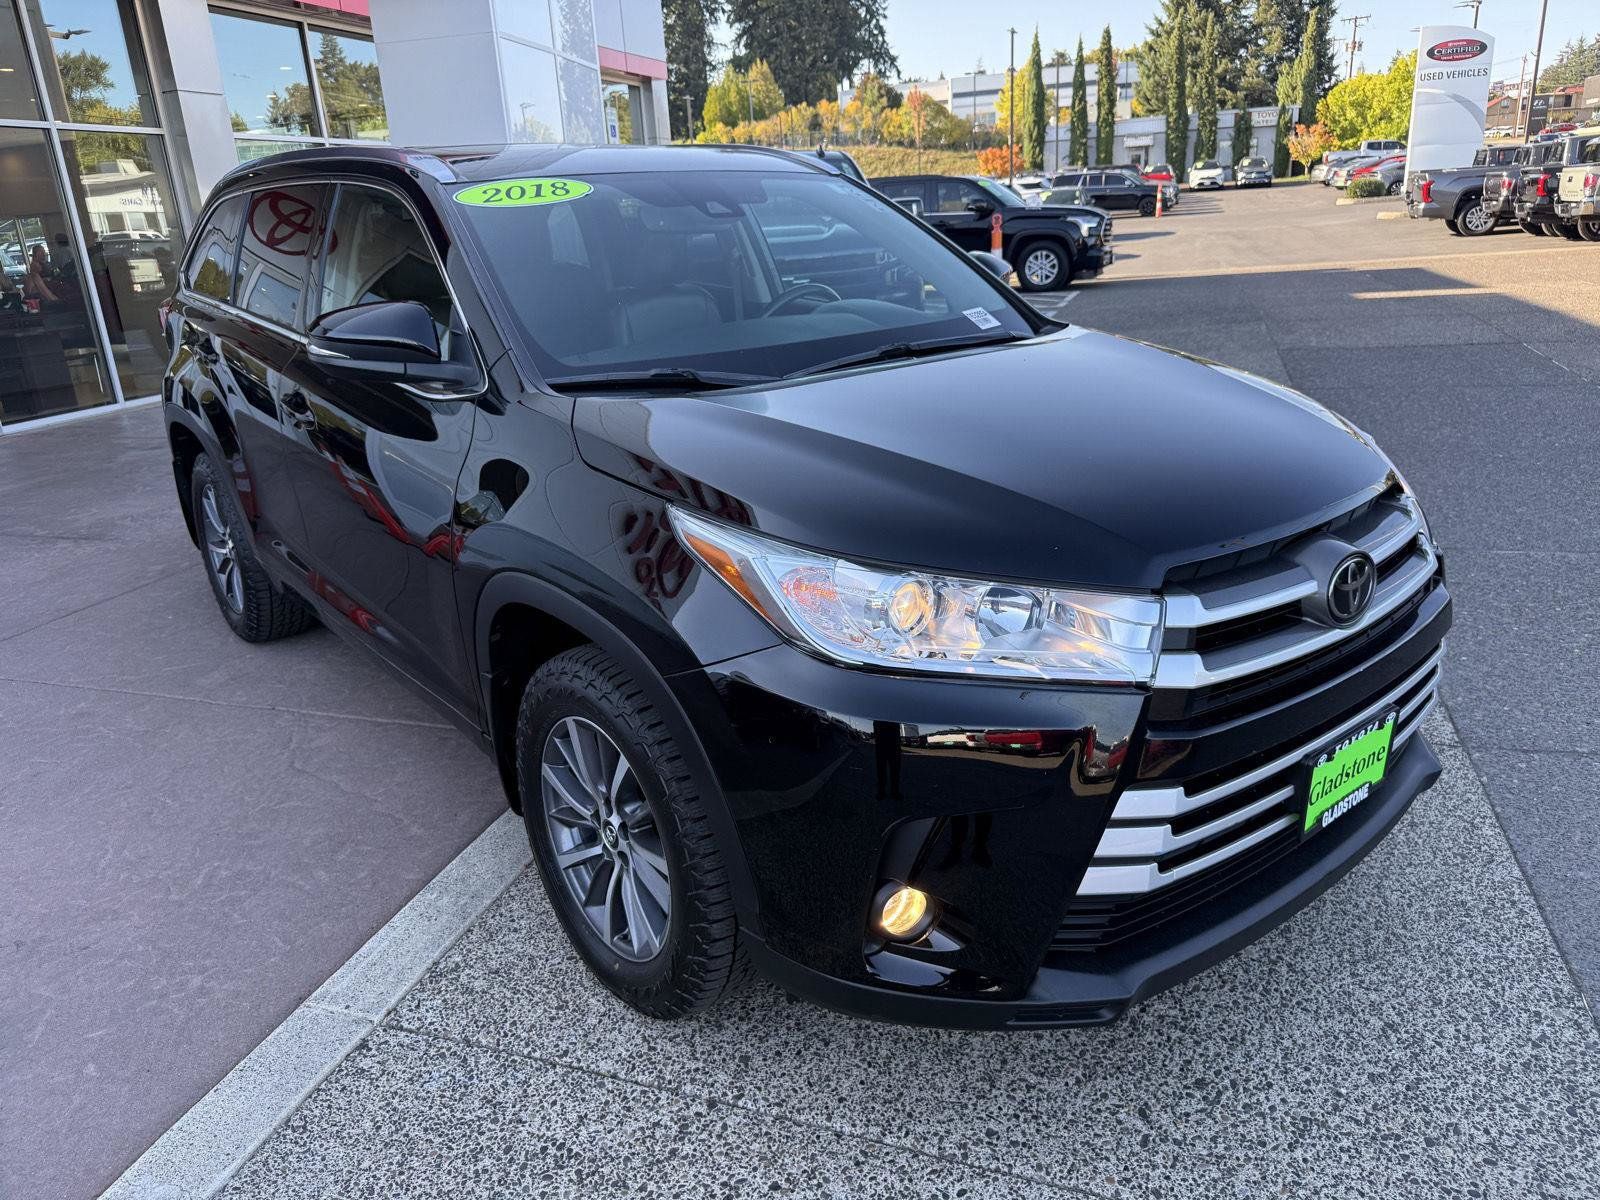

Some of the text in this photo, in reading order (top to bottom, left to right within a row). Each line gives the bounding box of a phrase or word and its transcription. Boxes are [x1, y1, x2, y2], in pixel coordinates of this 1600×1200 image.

[1434, 45, 1480, 56] CERTIFIED
[1420, 68, 1488, 82] USED VEHICLES
[481, 181, 570, 203] 2018
[1308, 745, 1386, 807] Gladstone
[1321, 782, 1370, 828] GLADSTONE
